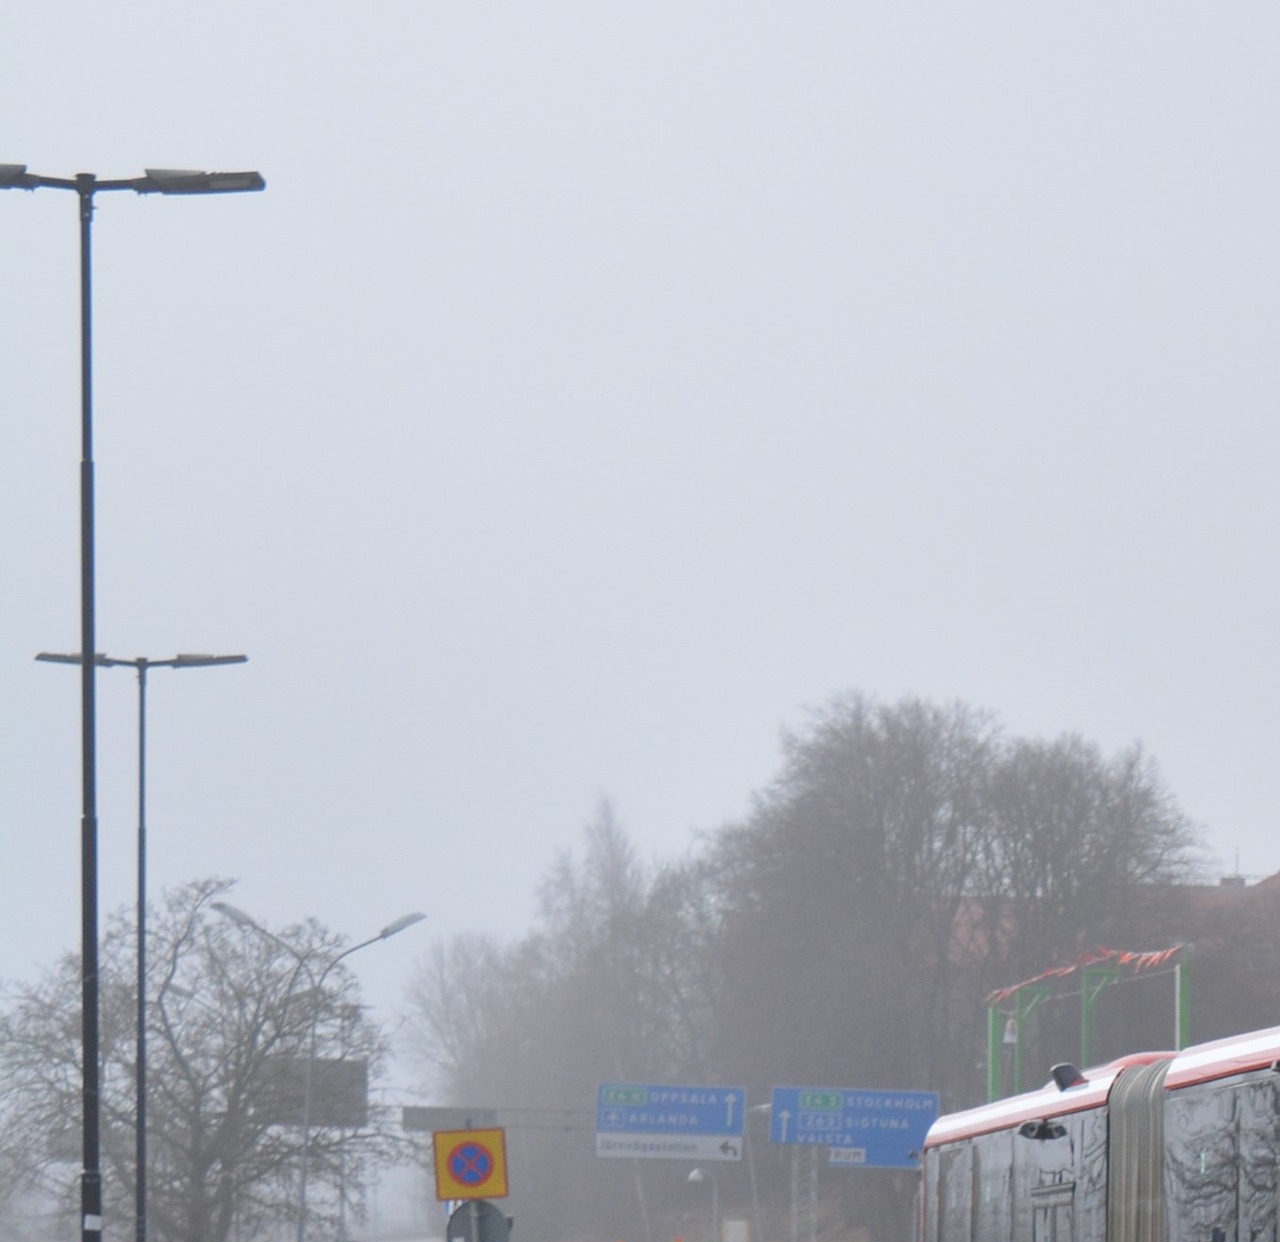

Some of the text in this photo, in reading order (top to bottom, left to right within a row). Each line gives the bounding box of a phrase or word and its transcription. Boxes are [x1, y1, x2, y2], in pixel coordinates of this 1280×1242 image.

[650, 1092, 718, 1104] UPPSALA
[846, 1097, 933, 1110] STOCKHOLM
[629, 1112, 698, 1126] ARLANDA
[845, 1117, 909, 1129] SIGTUNA
[796, 1133, 854, 1144] VALSTA
